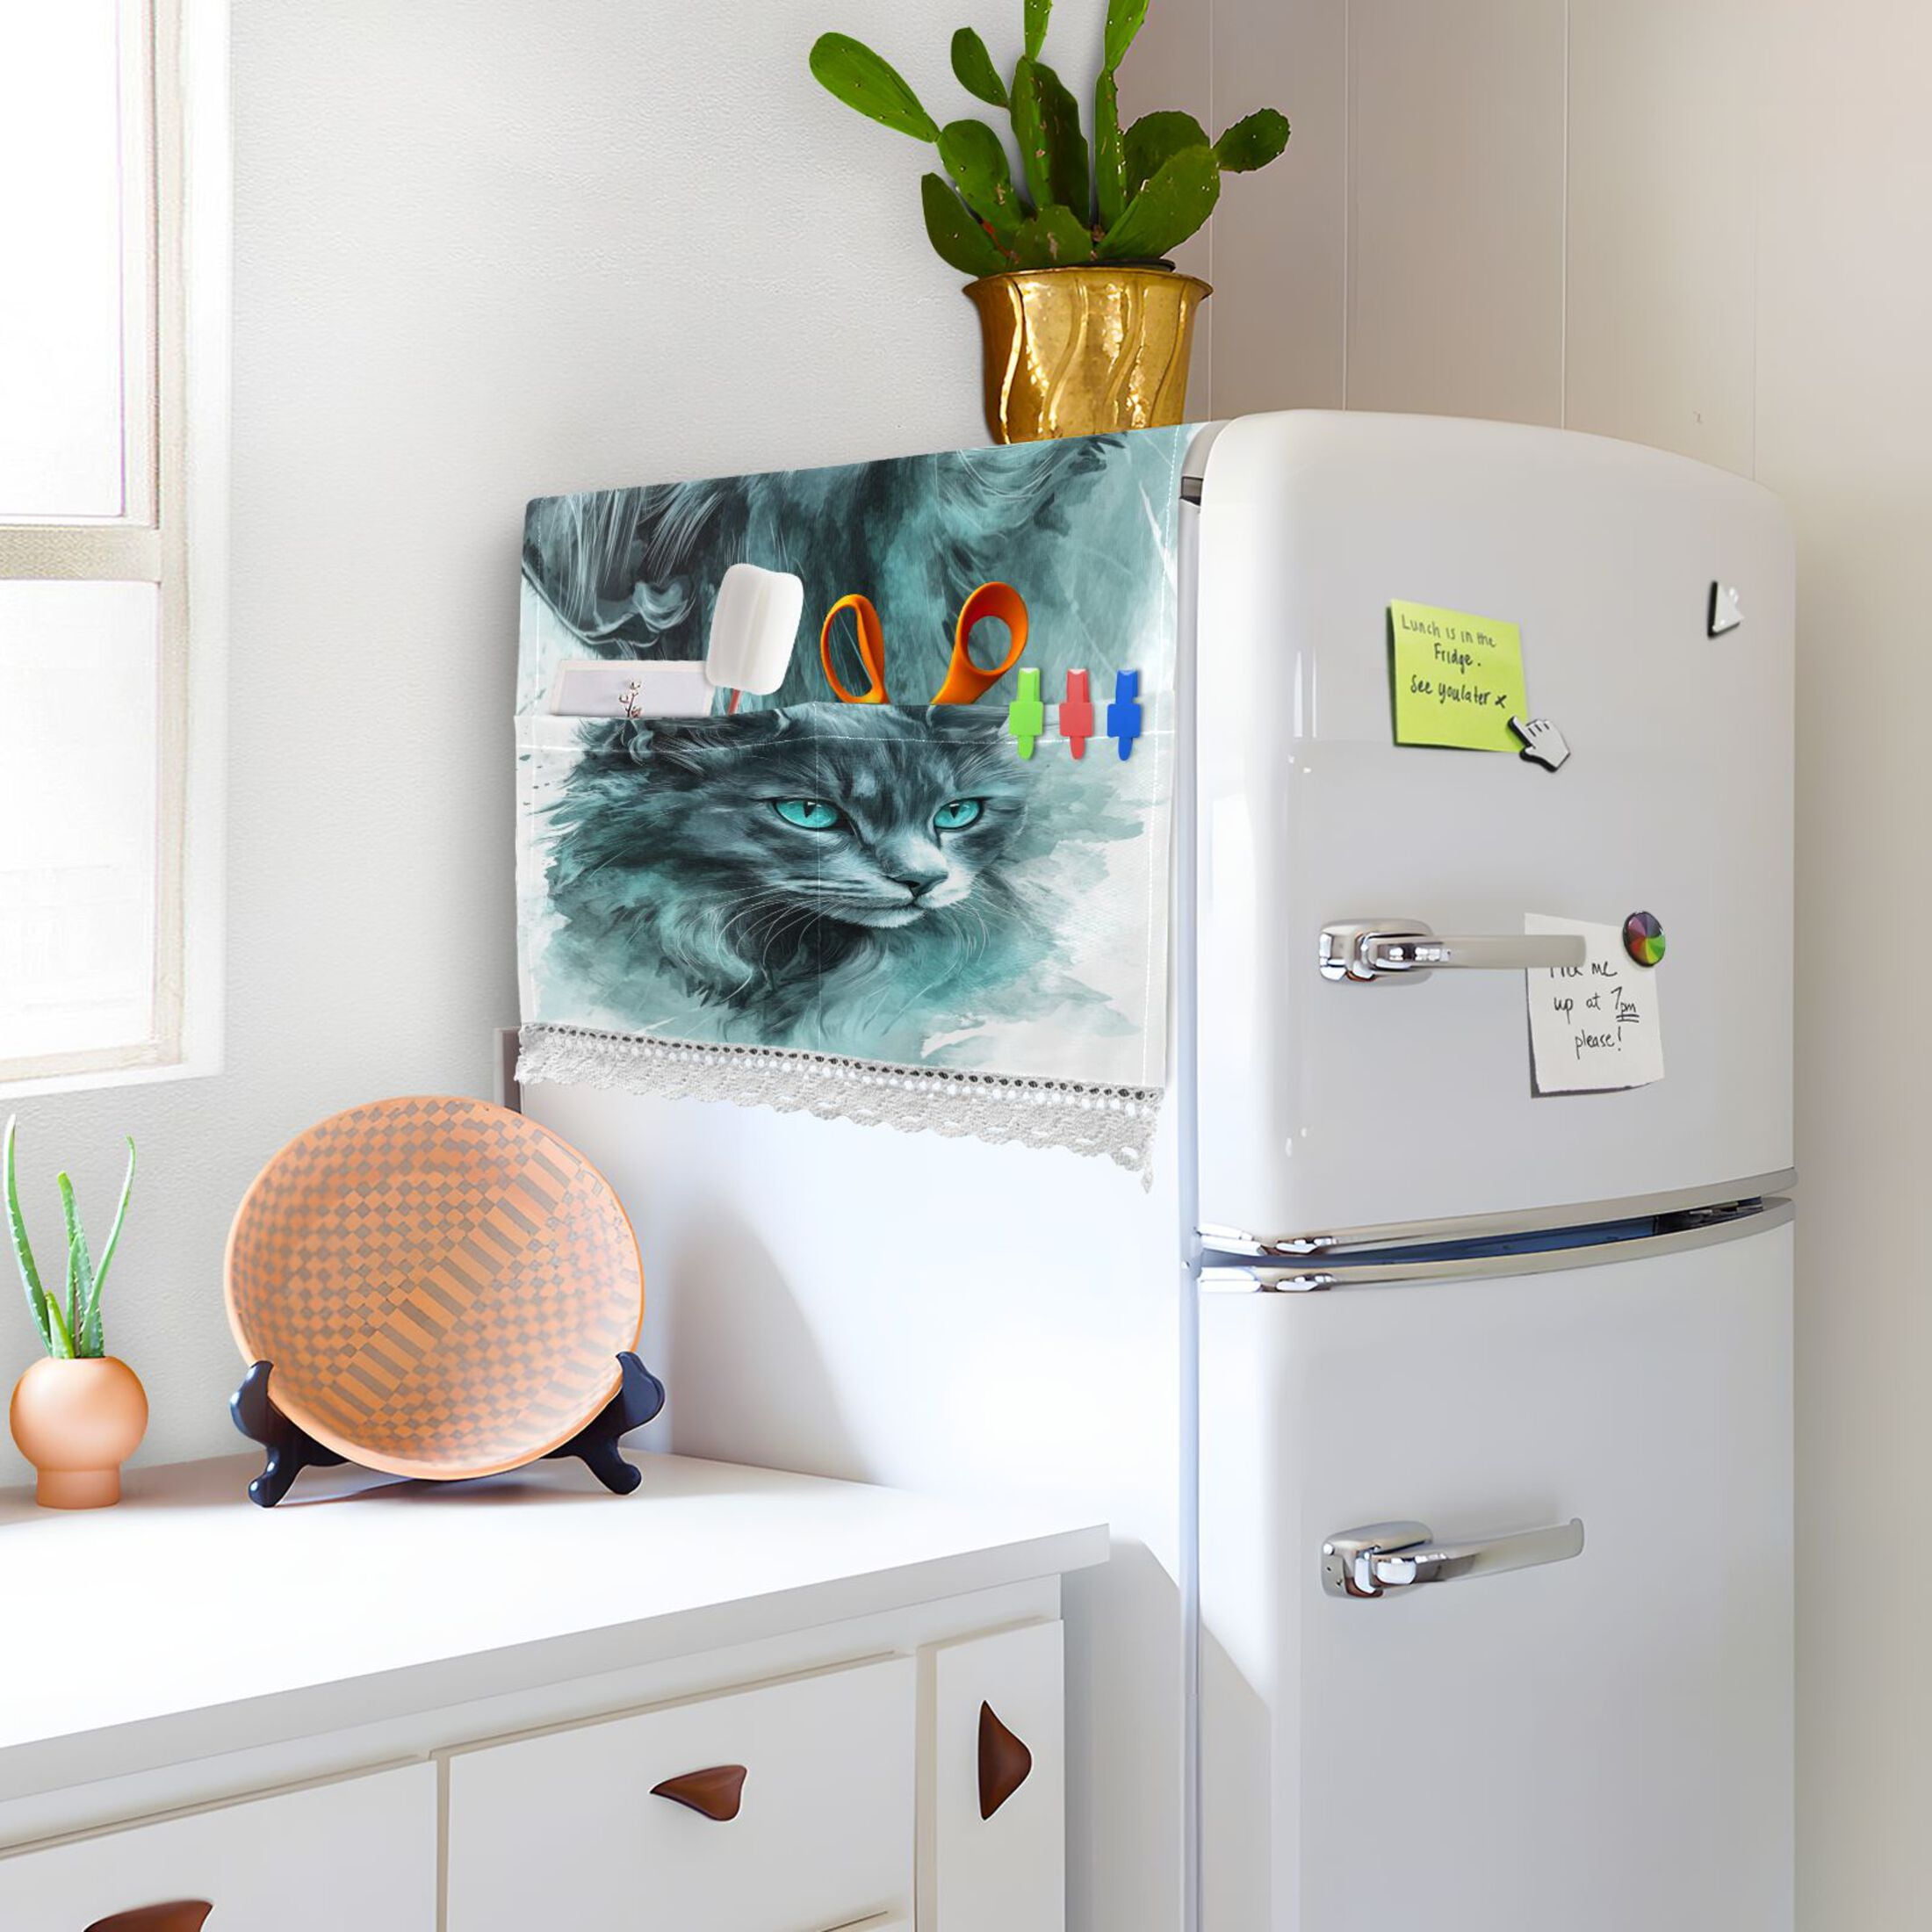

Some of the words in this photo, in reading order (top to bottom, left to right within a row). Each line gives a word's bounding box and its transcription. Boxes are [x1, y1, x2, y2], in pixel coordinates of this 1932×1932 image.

[1402, 614, 1441, 638] Lunch
[1476, 631, 1496, 648] the
[1410, 674, 1433, 695] See
[1591, 961, 1618, 977] me
[1554, 997, 1574, 1024] up
[1586, 992, 1602, 1011] at
[1575, 1026, 1622, 1060] please!
